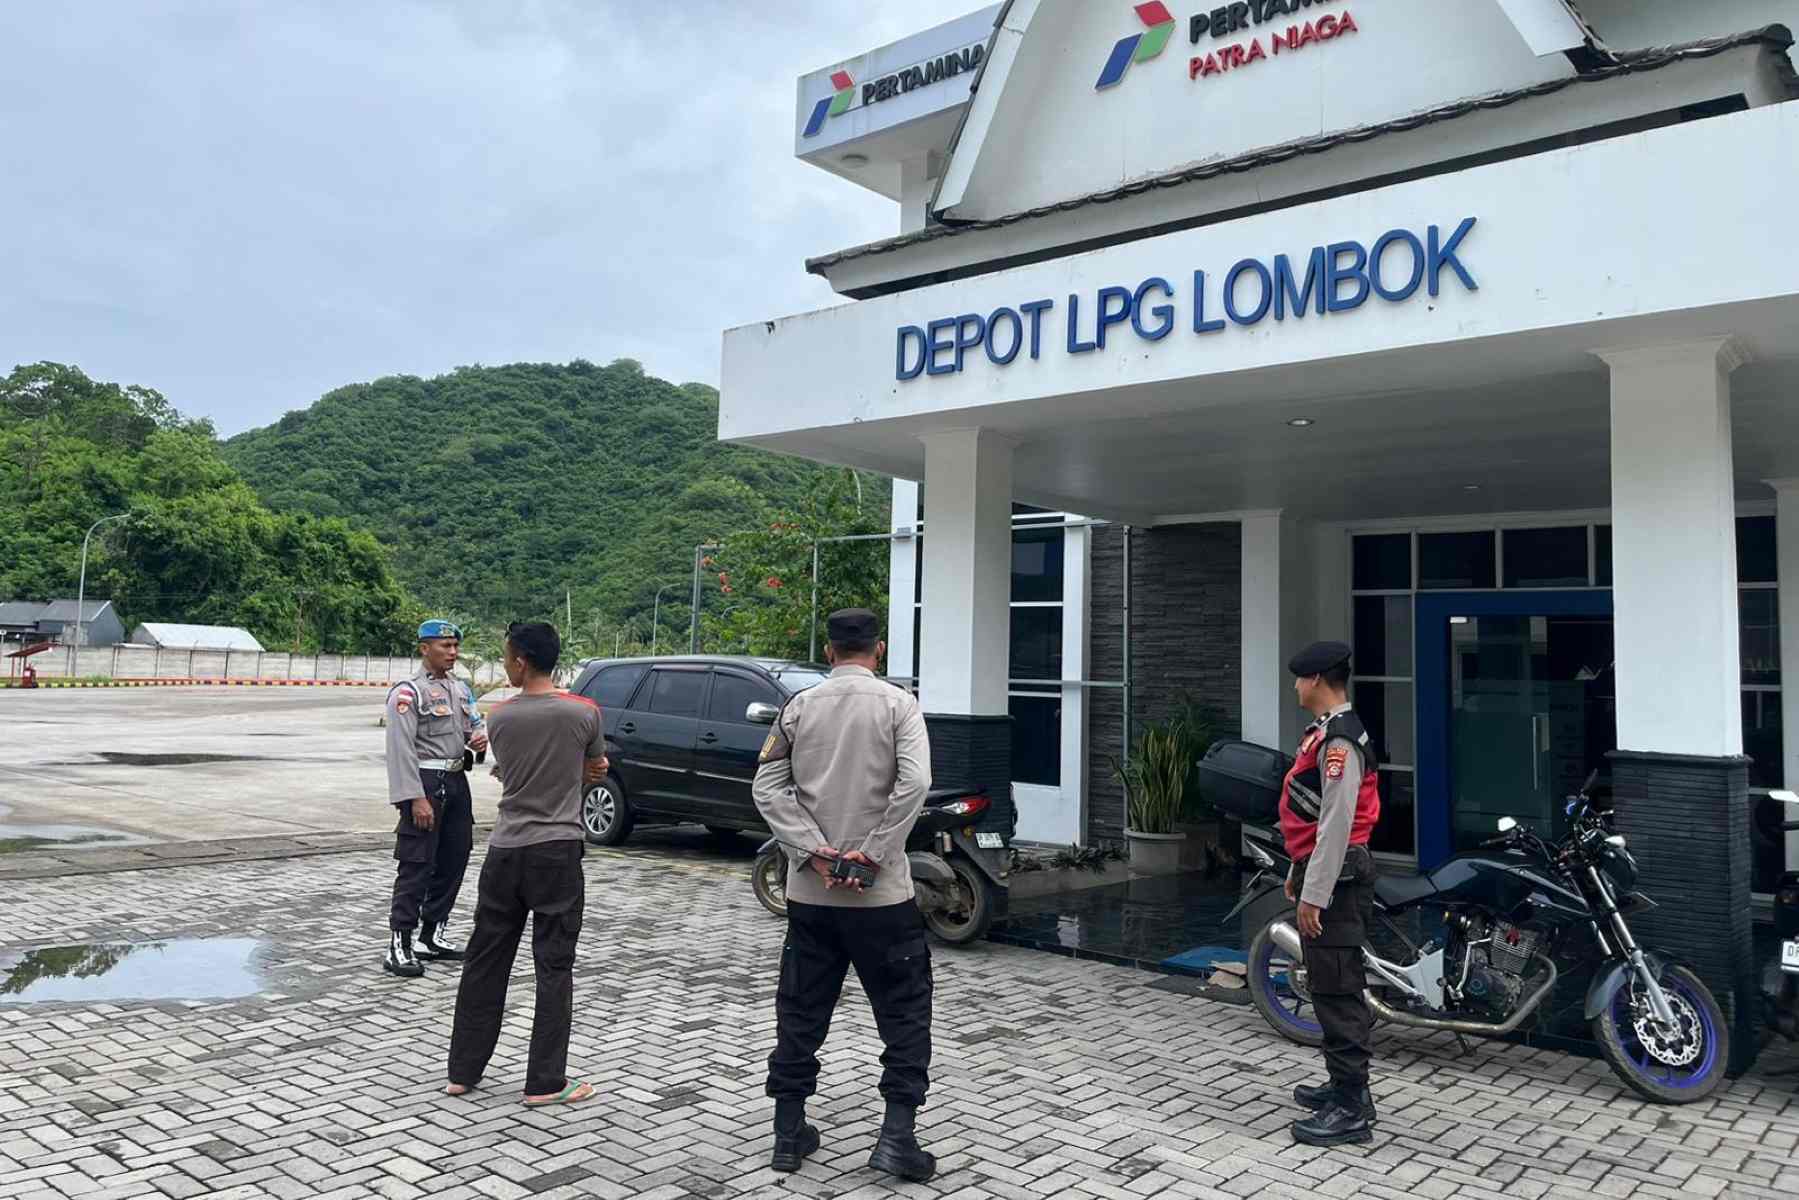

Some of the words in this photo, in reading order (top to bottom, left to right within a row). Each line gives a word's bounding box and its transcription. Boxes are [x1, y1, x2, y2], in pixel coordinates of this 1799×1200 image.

[1189, 37, 1266, 80] PATRA
[1272, 10, 1358, 55] NIAGA
[896, 299, 1053, 380] DEPOT
[1067, 277, 1174, 353] LPG
[1193, 216, 1479, 333] LOMBOK
